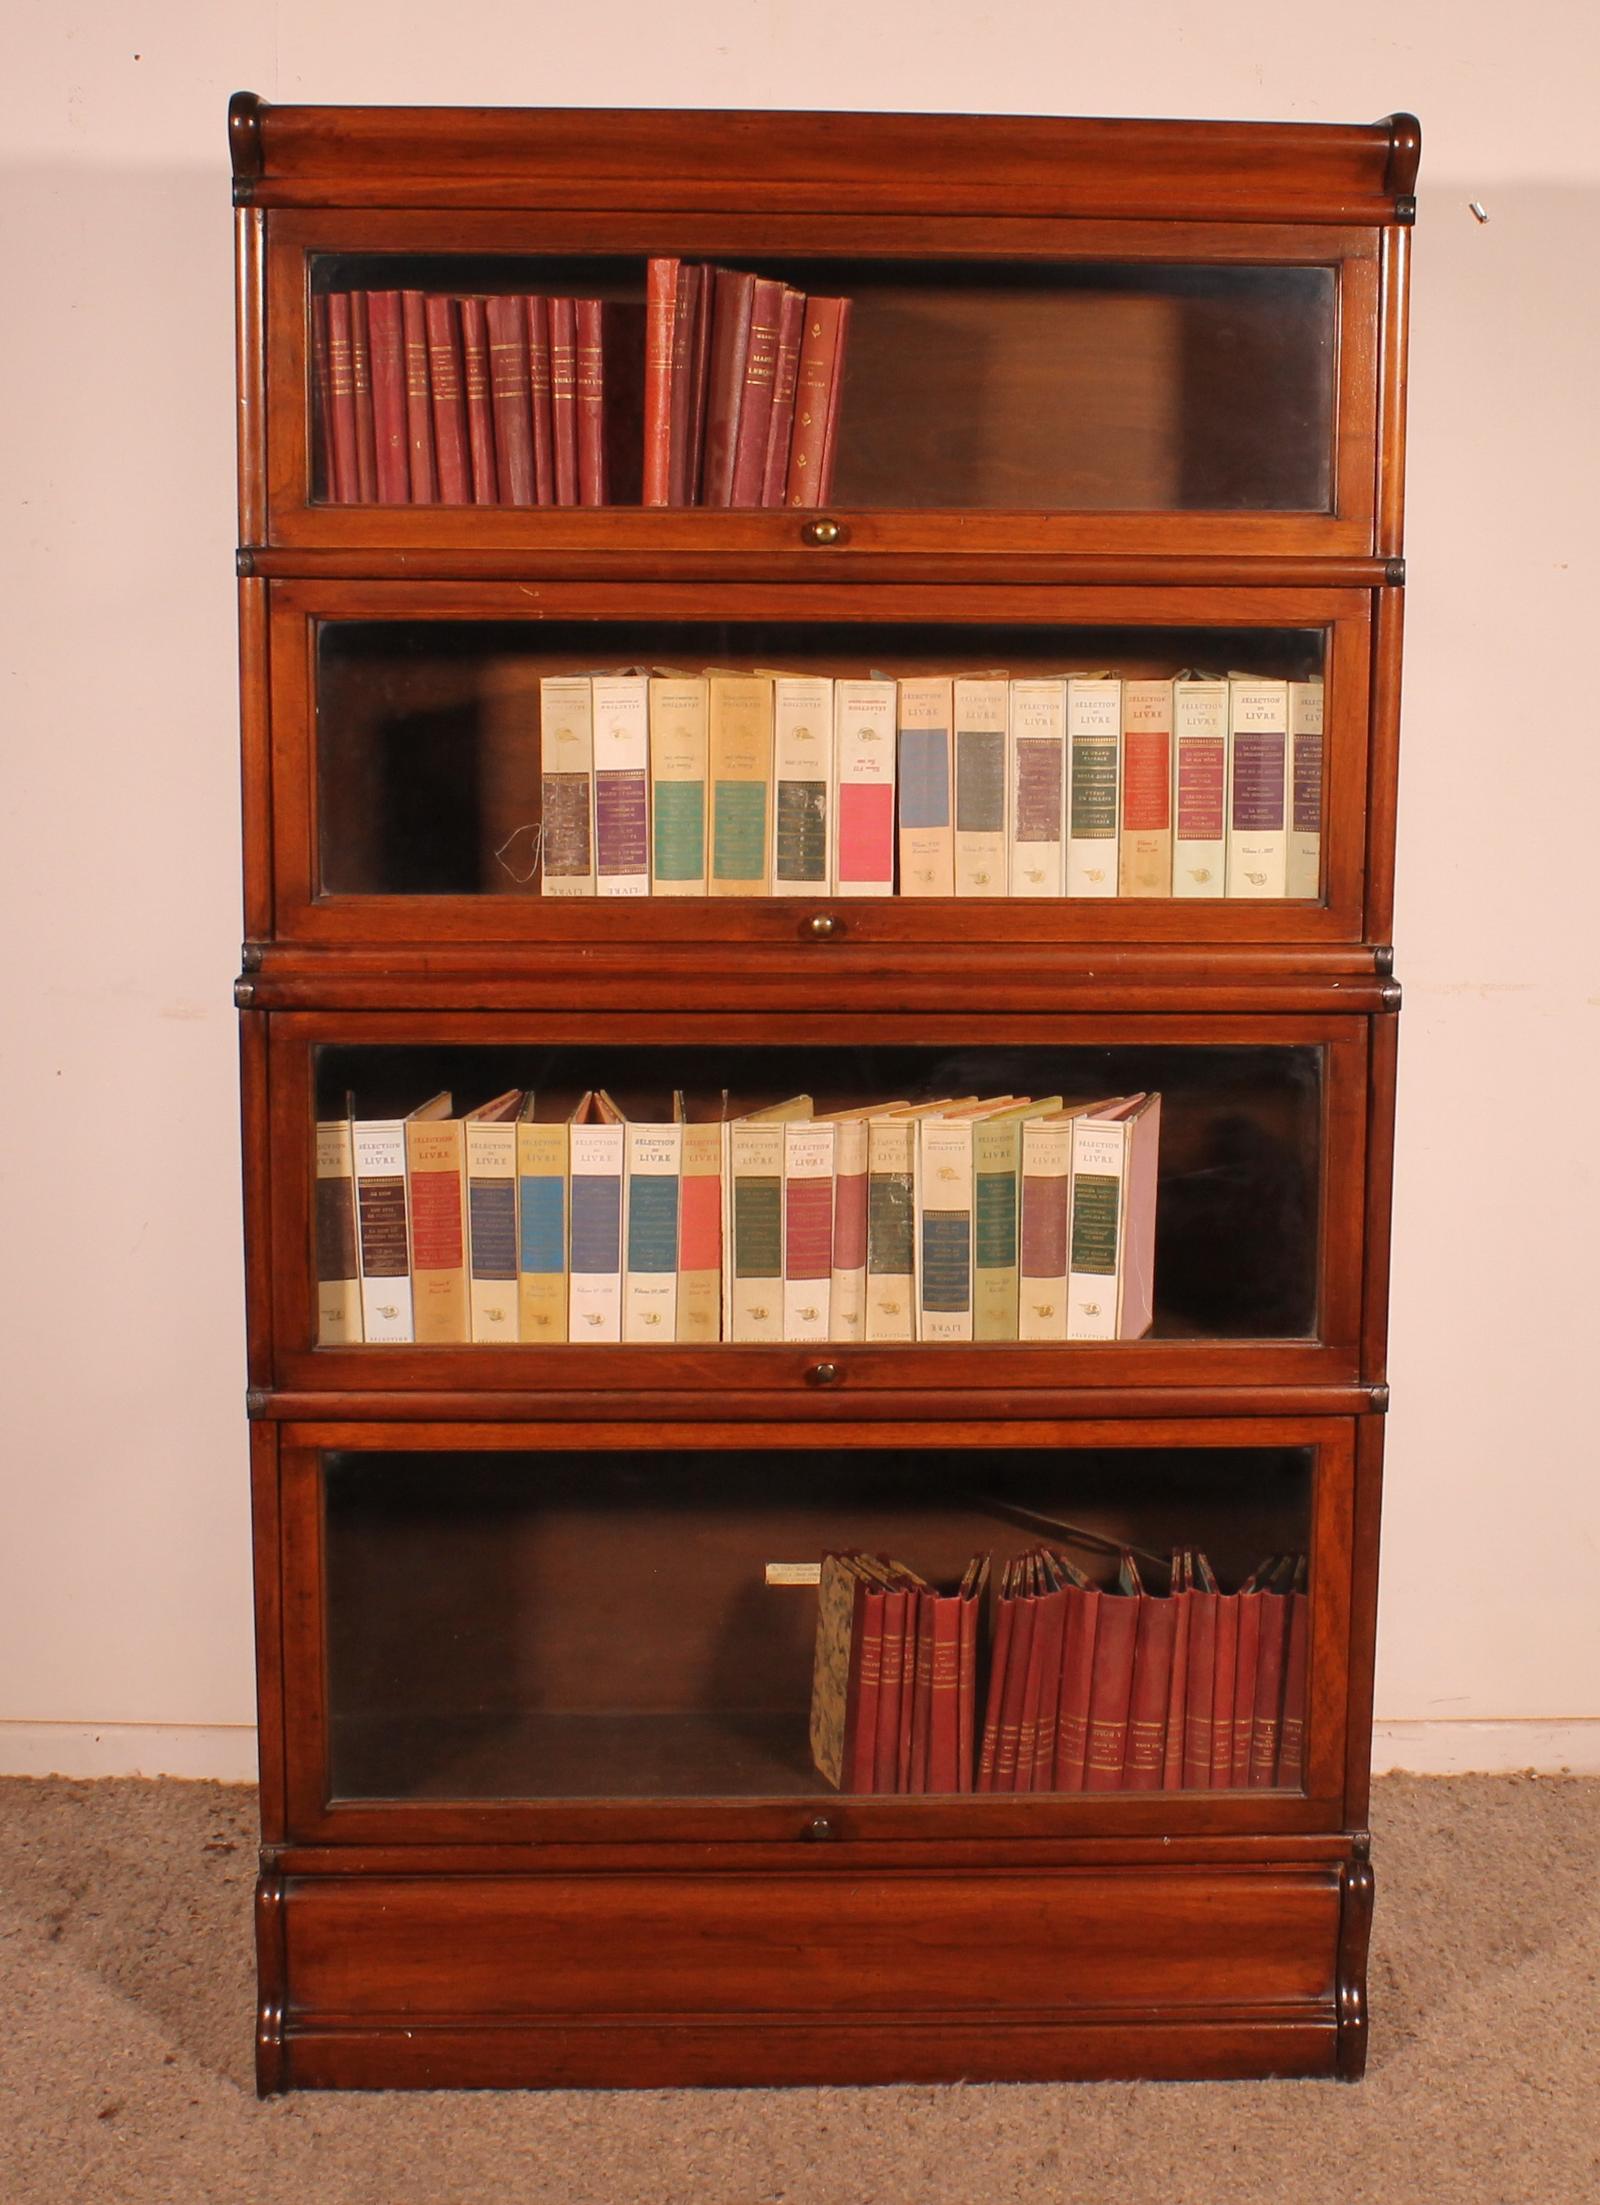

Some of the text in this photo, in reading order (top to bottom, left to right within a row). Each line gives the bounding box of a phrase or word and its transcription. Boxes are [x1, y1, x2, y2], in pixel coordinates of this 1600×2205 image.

[1133, 711, 1162, 719] LIVRE
[1245, 712, 1276, 720] LIVRE
[1080, 716, 1110, 724] LIVRE
[419, 1151, 449, 1160] LIVRE
[639, 1153, 671, 1162] LIVRE
[982, 1151, 1011, 1159] LIVRE
[1083, 1154, 1114, 1164] LIVRE
[364, 1157, 396, 1165] LIVRE
